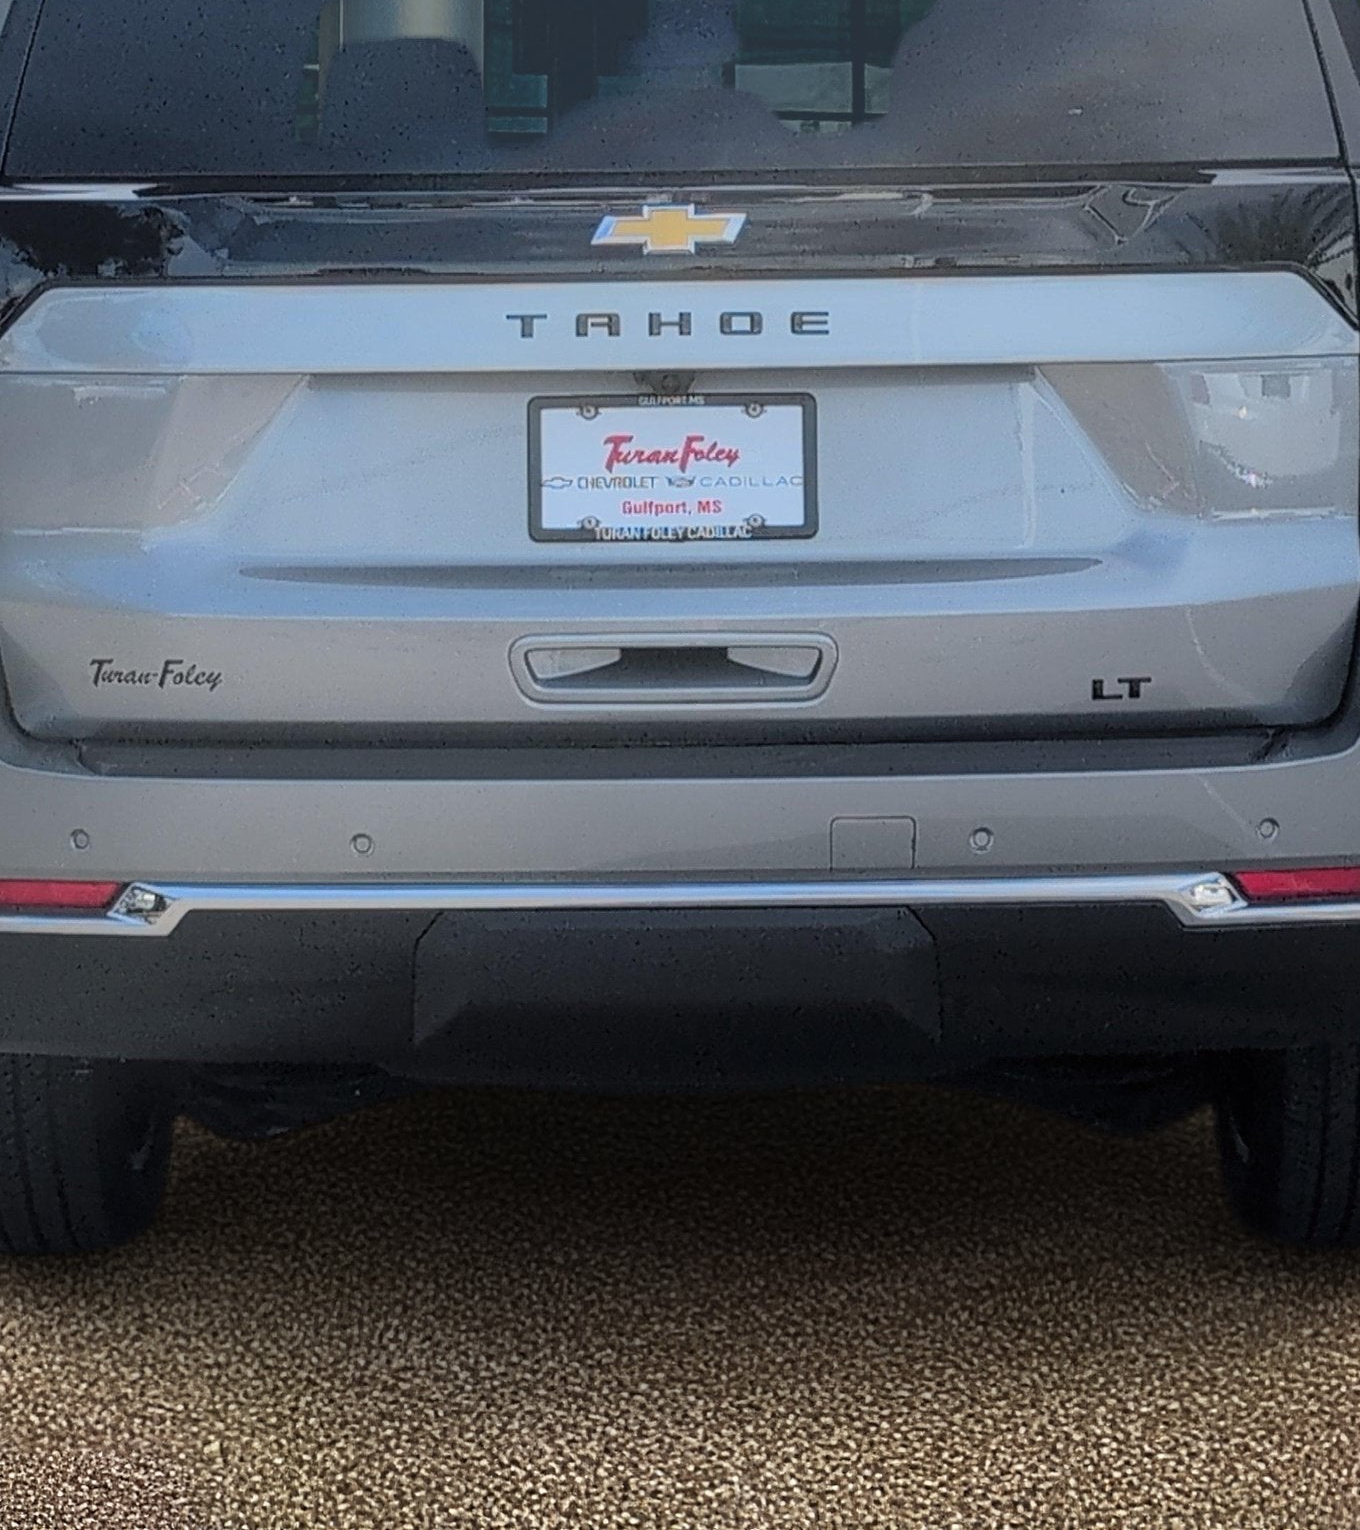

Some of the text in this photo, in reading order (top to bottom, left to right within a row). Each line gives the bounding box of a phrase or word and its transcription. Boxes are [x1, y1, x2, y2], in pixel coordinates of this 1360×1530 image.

[505, 311, 830, 338] TAHOE
[603, 435, 741, 473] Turan Foley
[577, 475, 803, 489] CHEVROLET CADILLAC
[622, 499, 722, 516] Gulfport, MS
[595, 525, 753, 540] TURAN FOLEY CADILLAC
[1092, 676, 1152, 700] LT
